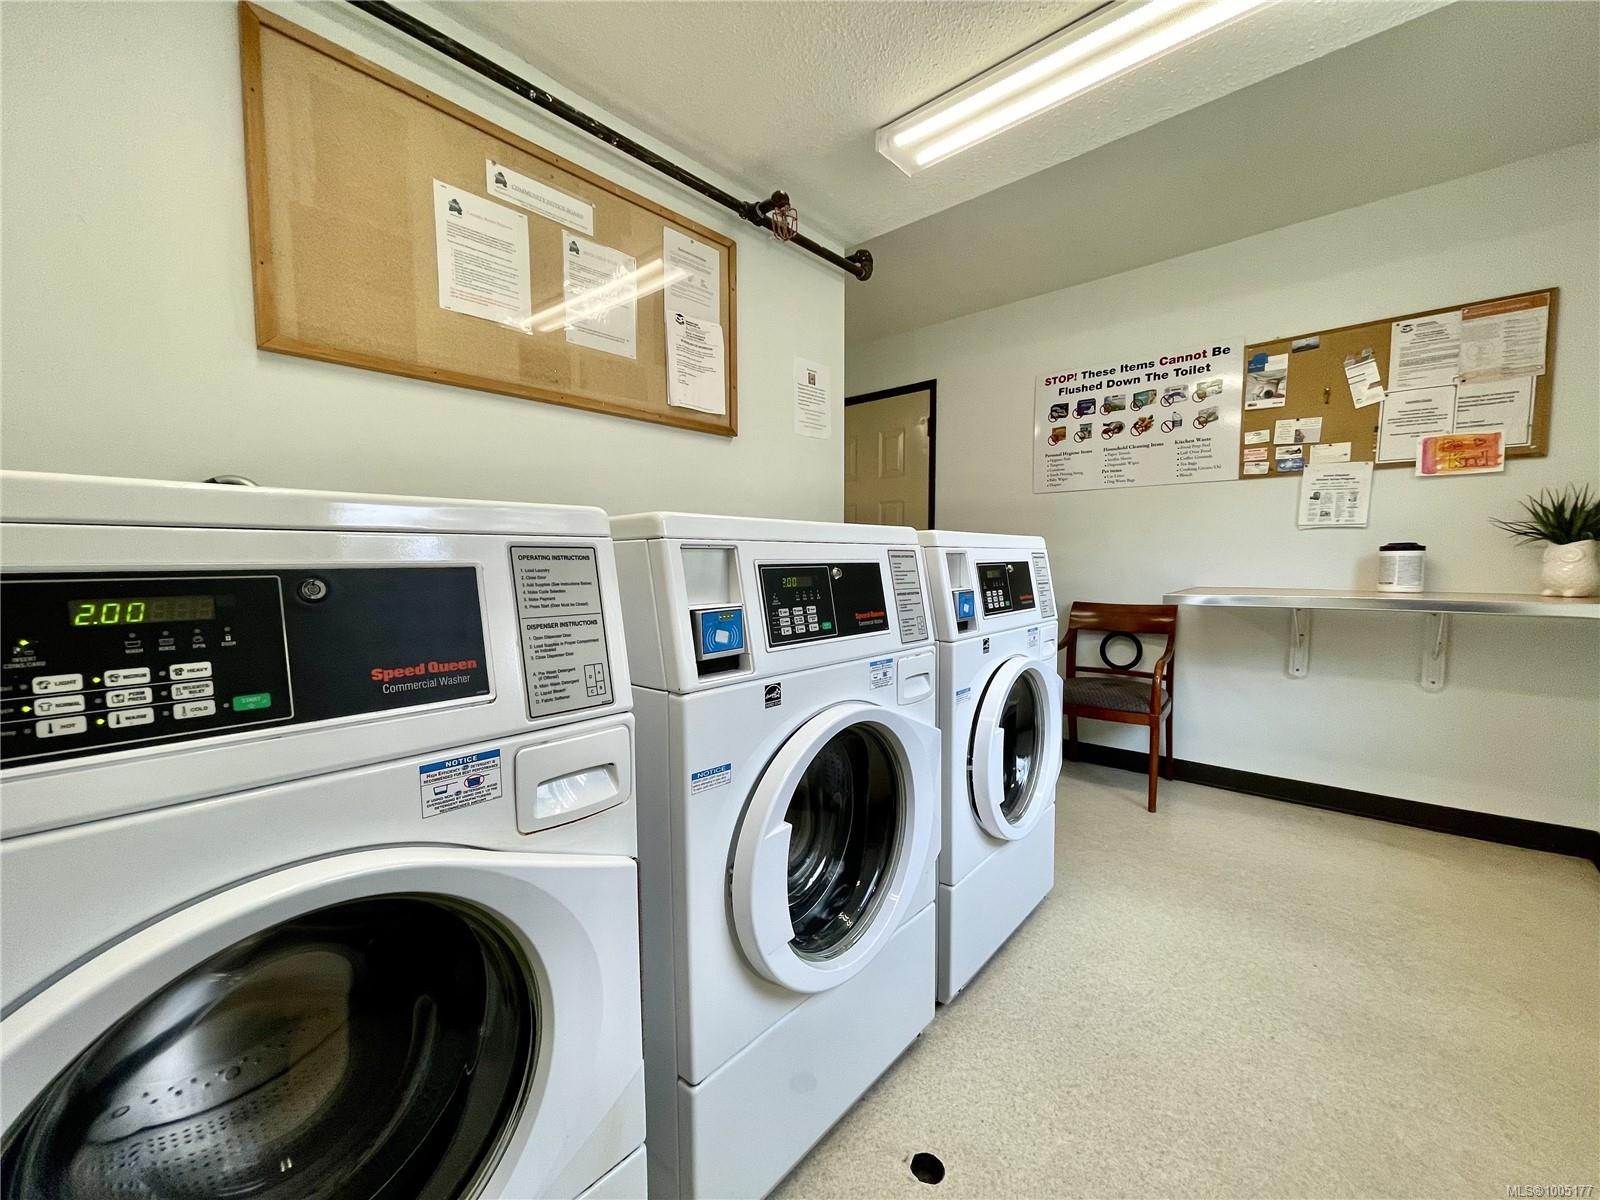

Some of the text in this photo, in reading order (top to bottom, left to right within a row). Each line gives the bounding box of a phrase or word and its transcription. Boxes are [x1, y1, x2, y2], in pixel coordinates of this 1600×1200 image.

[1044, 346, 1231, 386] STOP! These Items Cannot Be
[1058, 363, 1212, 396] Flushed Down The Toilet
[74, 602, 145, 626] 2.00
[370, 659, 477, 682] Speed Queen
[383, 674, 471, 694] Commercial Washer
[446, 754, 478, 767] NOTICE
[697, 766, 726, 779] NOTICE
